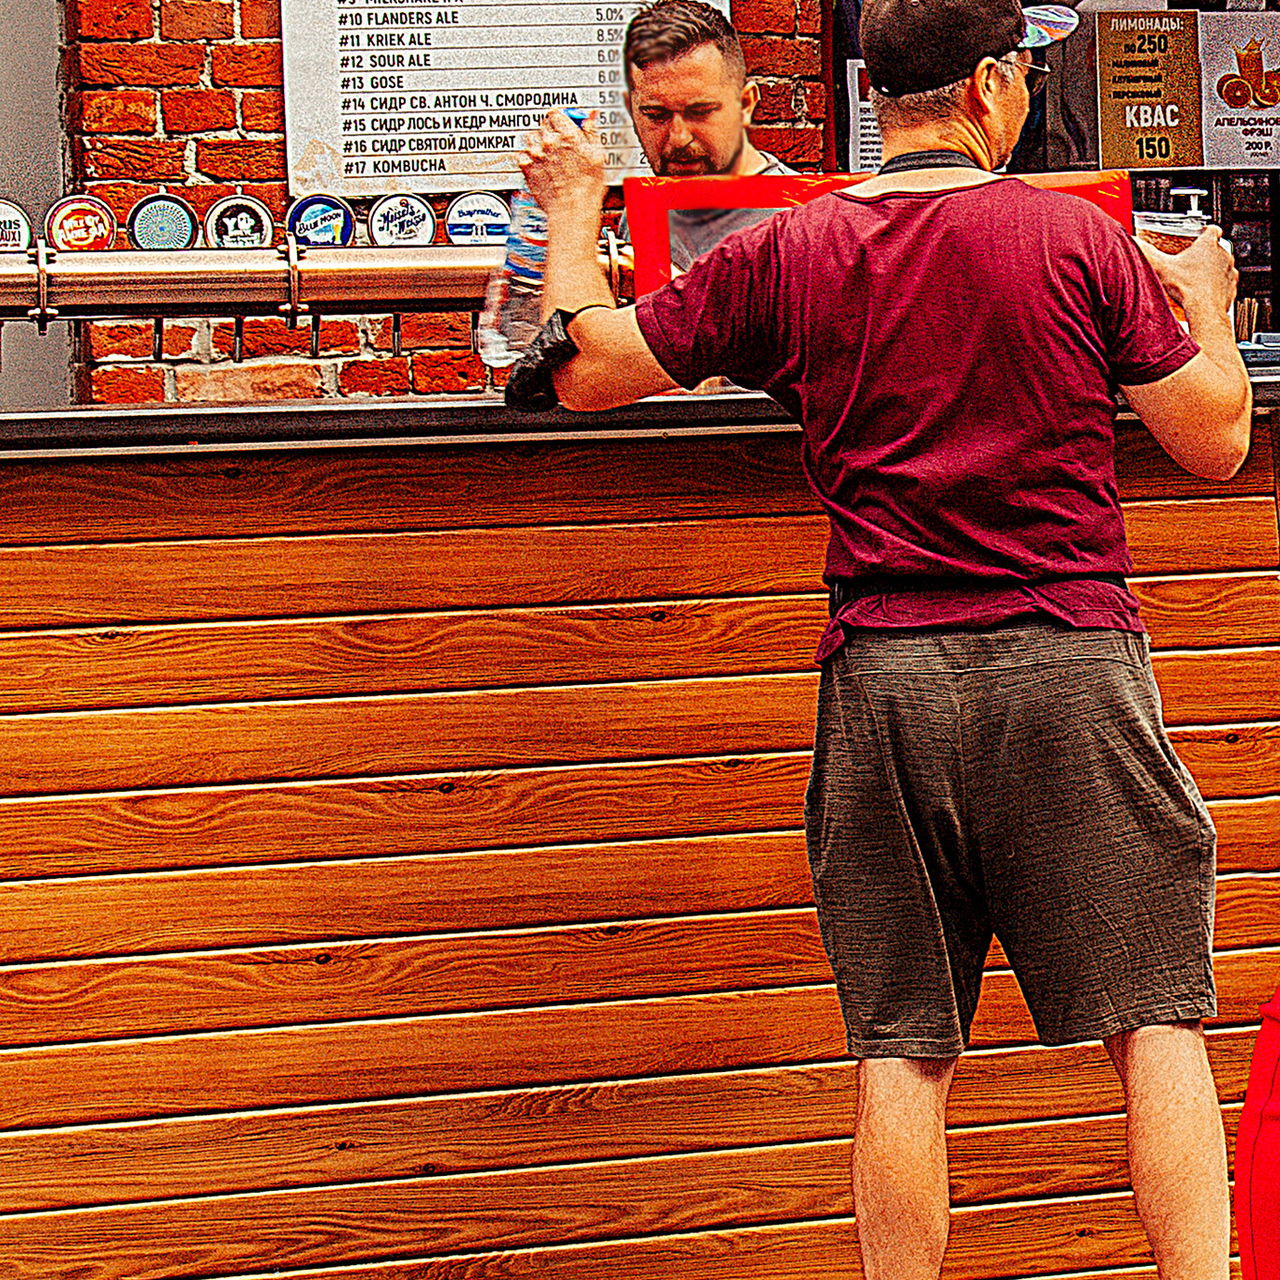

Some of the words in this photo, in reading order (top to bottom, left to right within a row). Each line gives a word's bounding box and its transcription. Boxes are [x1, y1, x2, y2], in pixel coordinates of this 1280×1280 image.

[338, 12, 362, 25] #10
[367, 12, 432, 25] FLANDERS
[436, 11, 459, 24] ALE
[596, 8, 623, 21] 5.0%
[1110, 17, 1184, 31] ЛИМОНАДЫ:
[339, 34, 360, 47] #11
[367, 34, 405, 46] KRIEK
[408, 33, 431, 45] ALE
[597, 29, 624, 42] 8.5%
[1137, 34, 1168, 53] 250
[340, 56, 364, 68] #12
[369, 54, 405, 67] SOUR
[408, 54, 431, 66] ALE
[340, 77, 364, 89] #13
[370, 76, 404, 89] GOSE
[341, 98, 365, 110] #14
[370, 97, 406, 111] СИДР
[410, 96, 430, 109] СВ.
[434, 95, 477, 108] АНТОН
[480, 95, 493, 107] Ч.
[496, 93, 578, 107] СМОРОДИНА
[342, 119, 366, 131] #15
[371, 118, 405, 132] СИДР
[407, 117, 440, 129] ЛОСЬ
[443, 116, 451, 129] И
[454, 115, 486, 129] КЕДР
[489, 114, 530, 127] МАНГО
[1125, 105, 1179, 127] КВАС
[1242, 128, 1273, 137] ФРЭШ
[343, 141, 367, 153] #16
[372, 139, 406, 153] СИДР
[408, 134, 456, 151] СВЯТОЙ
[458, 136, 516, 151] ДОМКРАТ
[1135, 137, 1170, 159] 150
[1245, 141, 1263, 150] 200
[344, 161, 366, 174] #17
[373, 158, 446, 172] KOMBUCHA
